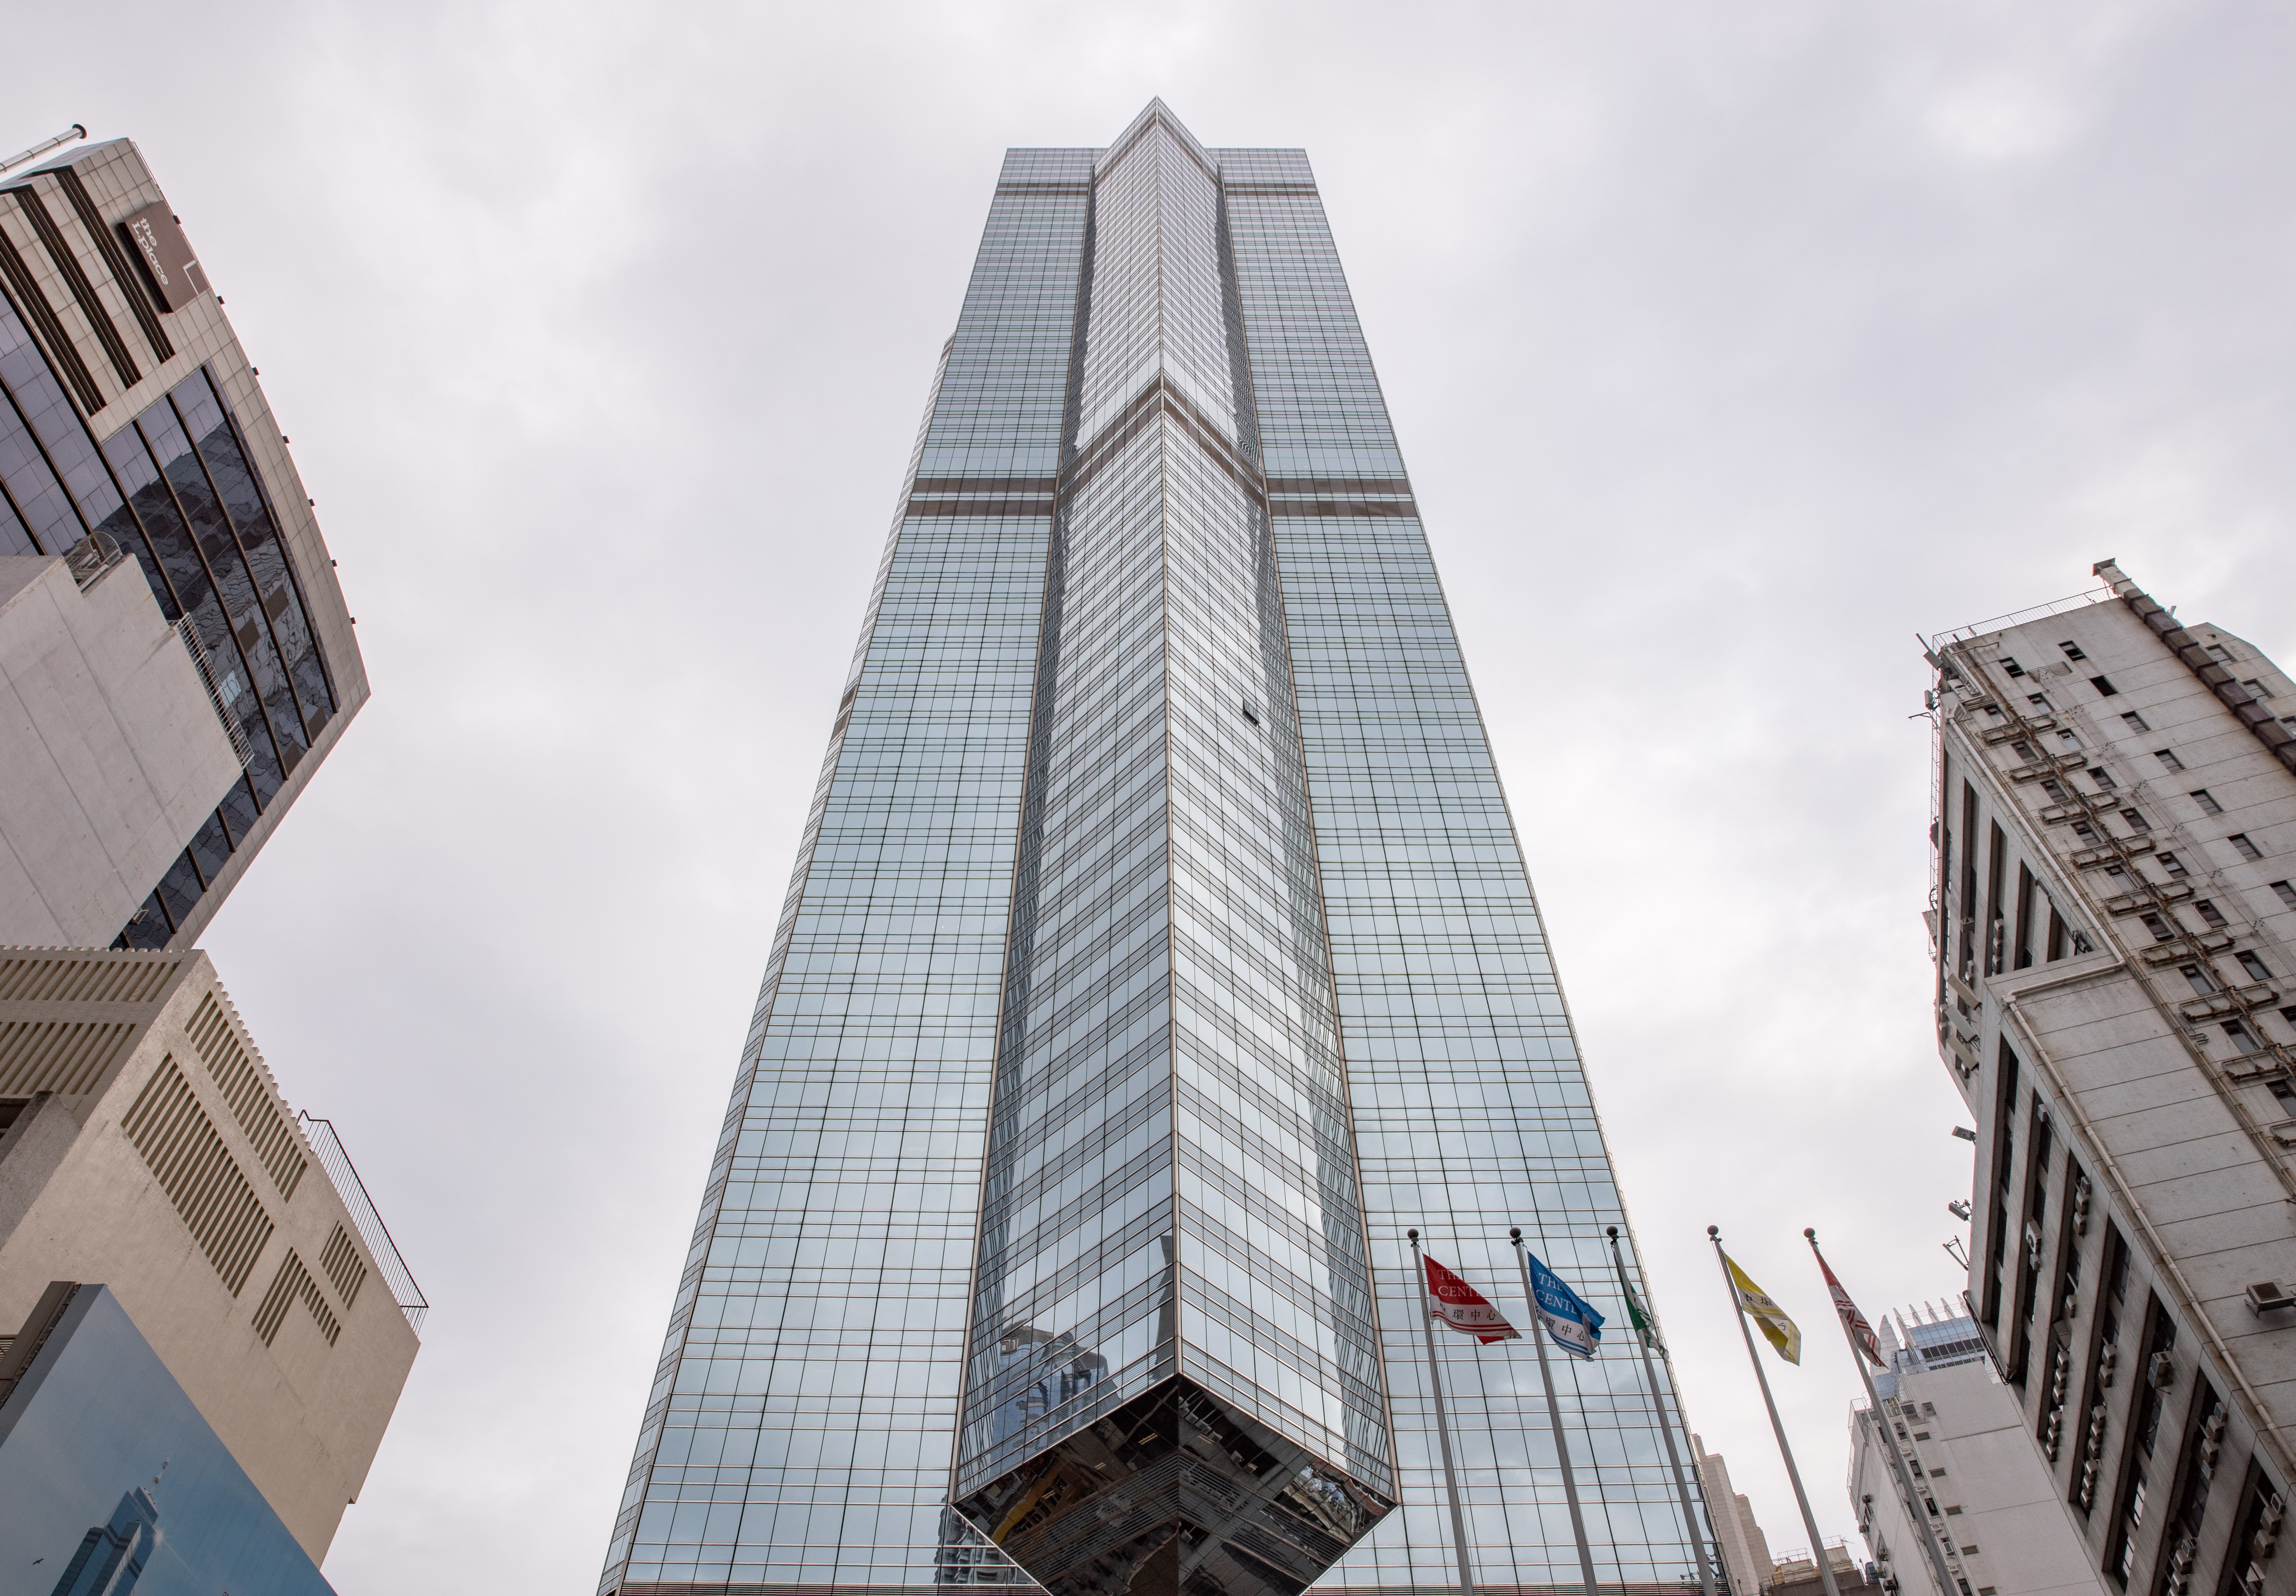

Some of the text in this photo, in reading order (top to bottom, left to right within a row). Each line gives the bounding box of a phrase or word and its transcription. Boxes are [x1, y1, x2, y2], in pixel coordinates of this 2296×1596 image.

[140, 218, 157, 246] the
[1438, 1269, 1461, 1280] TH
[1438, 1286, 1482, 1297] CENT
